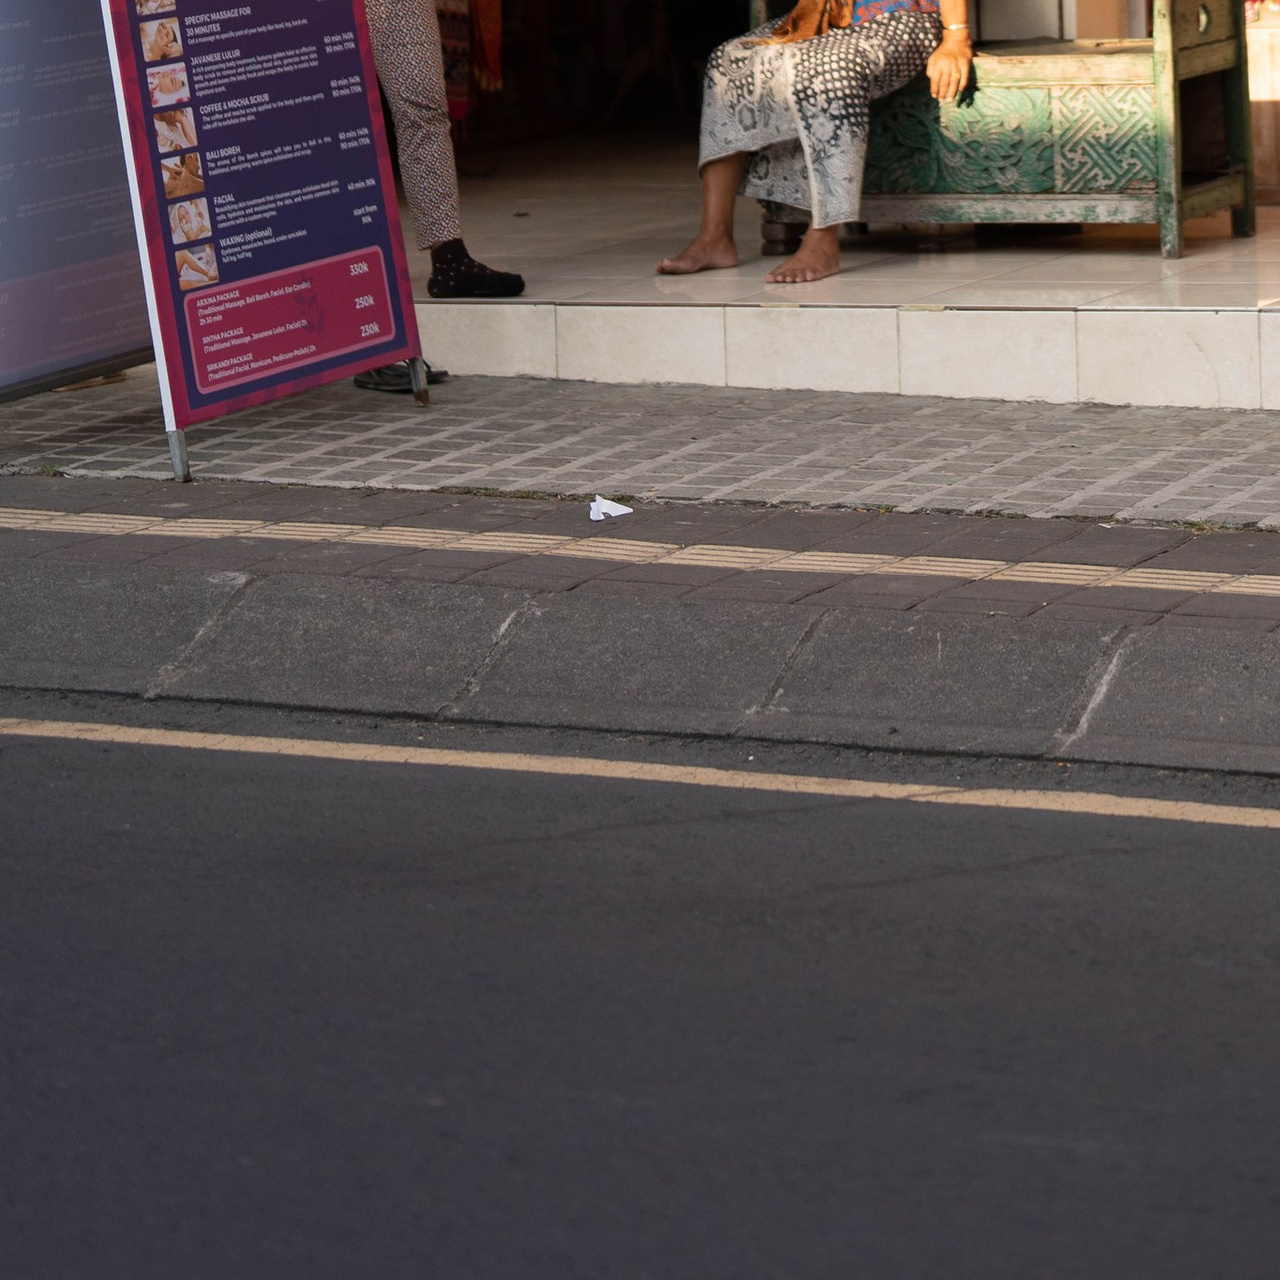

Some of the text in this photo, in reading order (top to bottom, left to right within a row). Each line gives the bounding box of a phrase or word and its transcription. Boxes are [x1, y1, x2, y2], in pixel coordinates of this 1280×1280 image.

[184, 6, 251, 25] SPECIFIC MASSAGE FOR
[194, 23, 221, 35] MINUTES
[191, 49, 240, 65] JAVANESE LULUR
[199, 102, 222, 114] COFFEE
[227, 97, 250, 108] MOCHA
[249, 93, 269, 104] SCRUB
[206, 145, 241, 160] BALI BOREH
[213, 194, 235, 205] FACIAL
[353, 205, 378, 216] start from
[219, 227, 272, 247] WAXING (optional)
[349, 261, 369, 276] 330k
[216, 290, 240, 302] PACKAGE
[246, 295, 256, 304] Bali
[285, 286, 293, 294] Ear
[355, 294, 374, 309] 250k
[220, 327, 244, 339] PACKAGE
[252, 330, 273, 340] Javanese
[360, 322, 380, 337] 230k
[230, 353, 253, 365] PACKAGE
